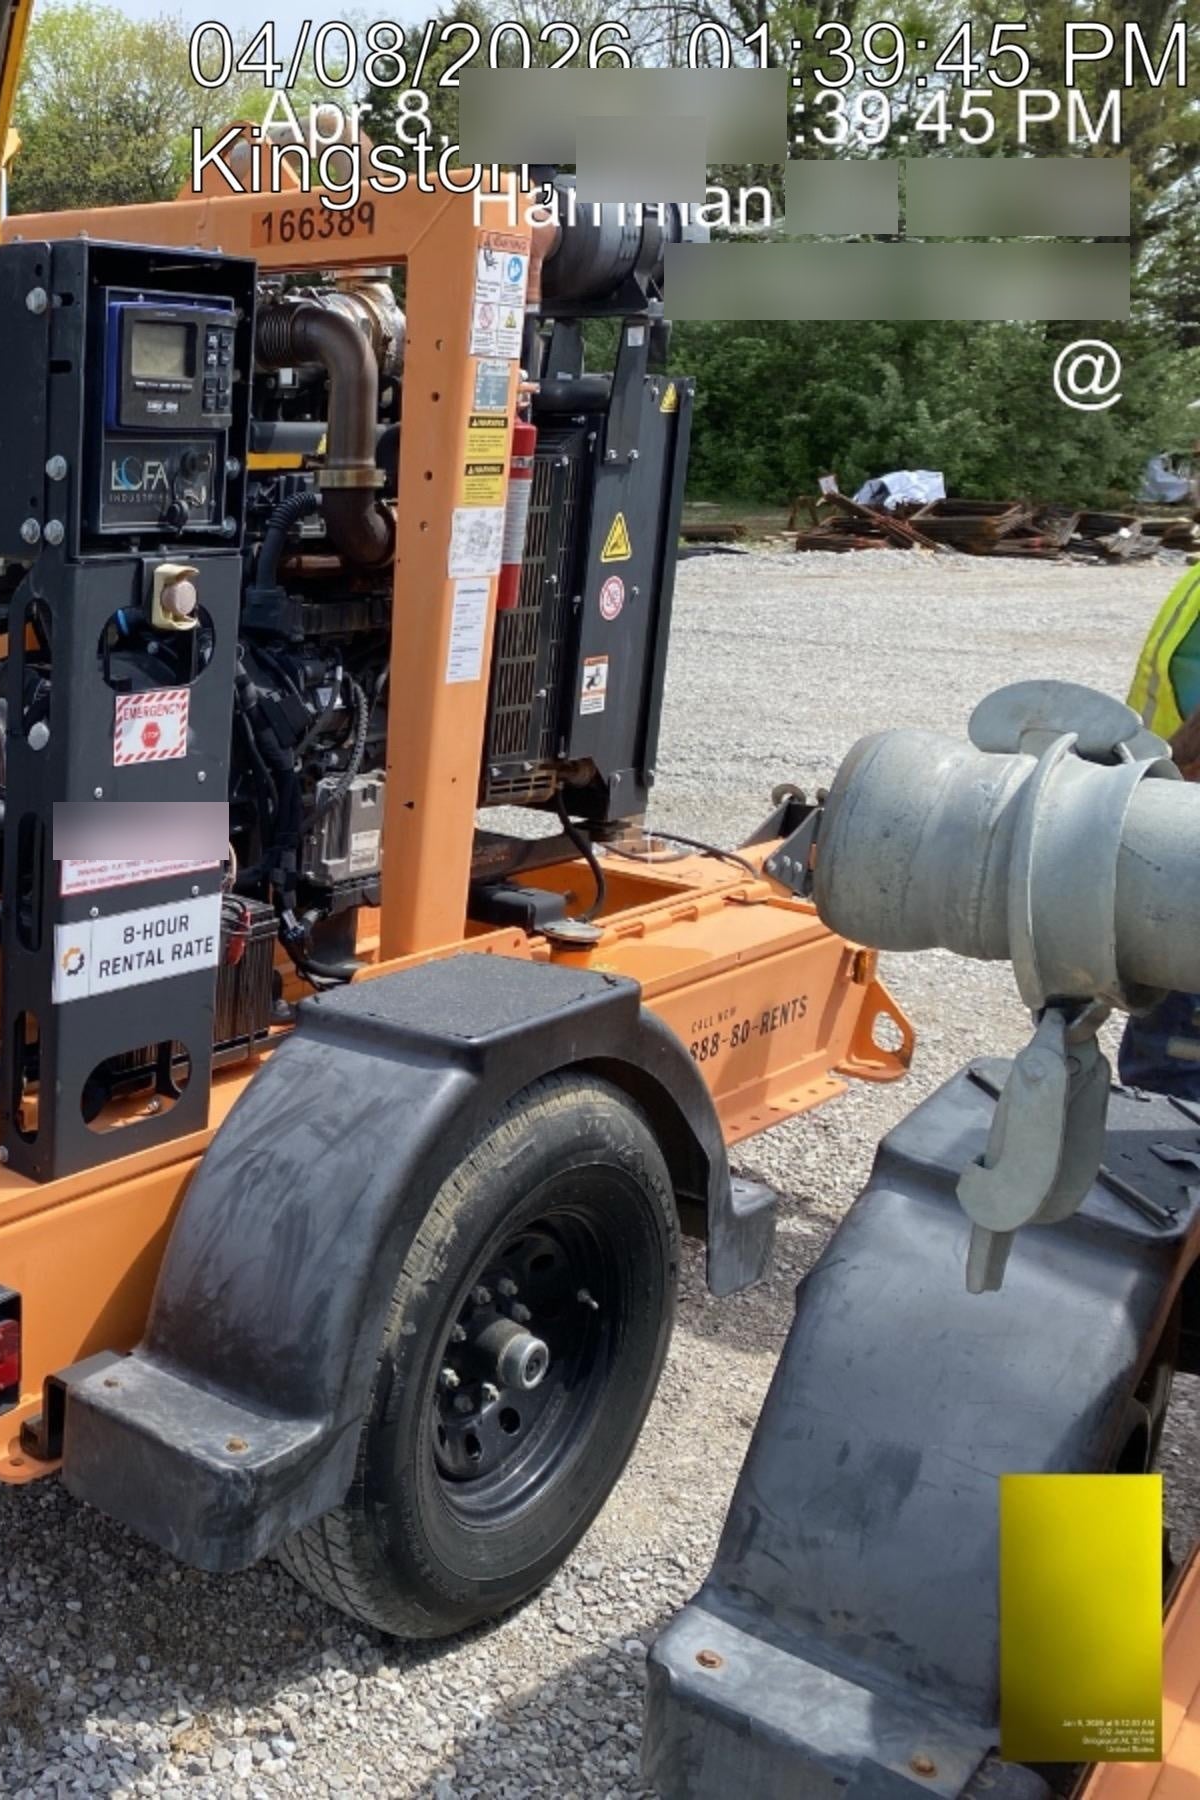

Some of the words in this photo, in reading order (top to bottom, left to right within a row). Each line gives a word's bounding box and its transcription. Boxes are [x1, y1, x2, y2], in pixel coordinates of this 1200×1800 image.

[261, 201, 376, 244] 166389
[111, 455, 170, 491] LOFA
[123, 703, 181, 720] EMERGENCY
[143, 731, 159, 740] STOP
[123, 915, 190, 945] 8-HOUR
[99, 949, 165, 979] RENTAL
[171, 936, 214, 962] RATE
[691, 1015, 714, 1033] CALL
[718, 1007, 737, 1023] NOW
